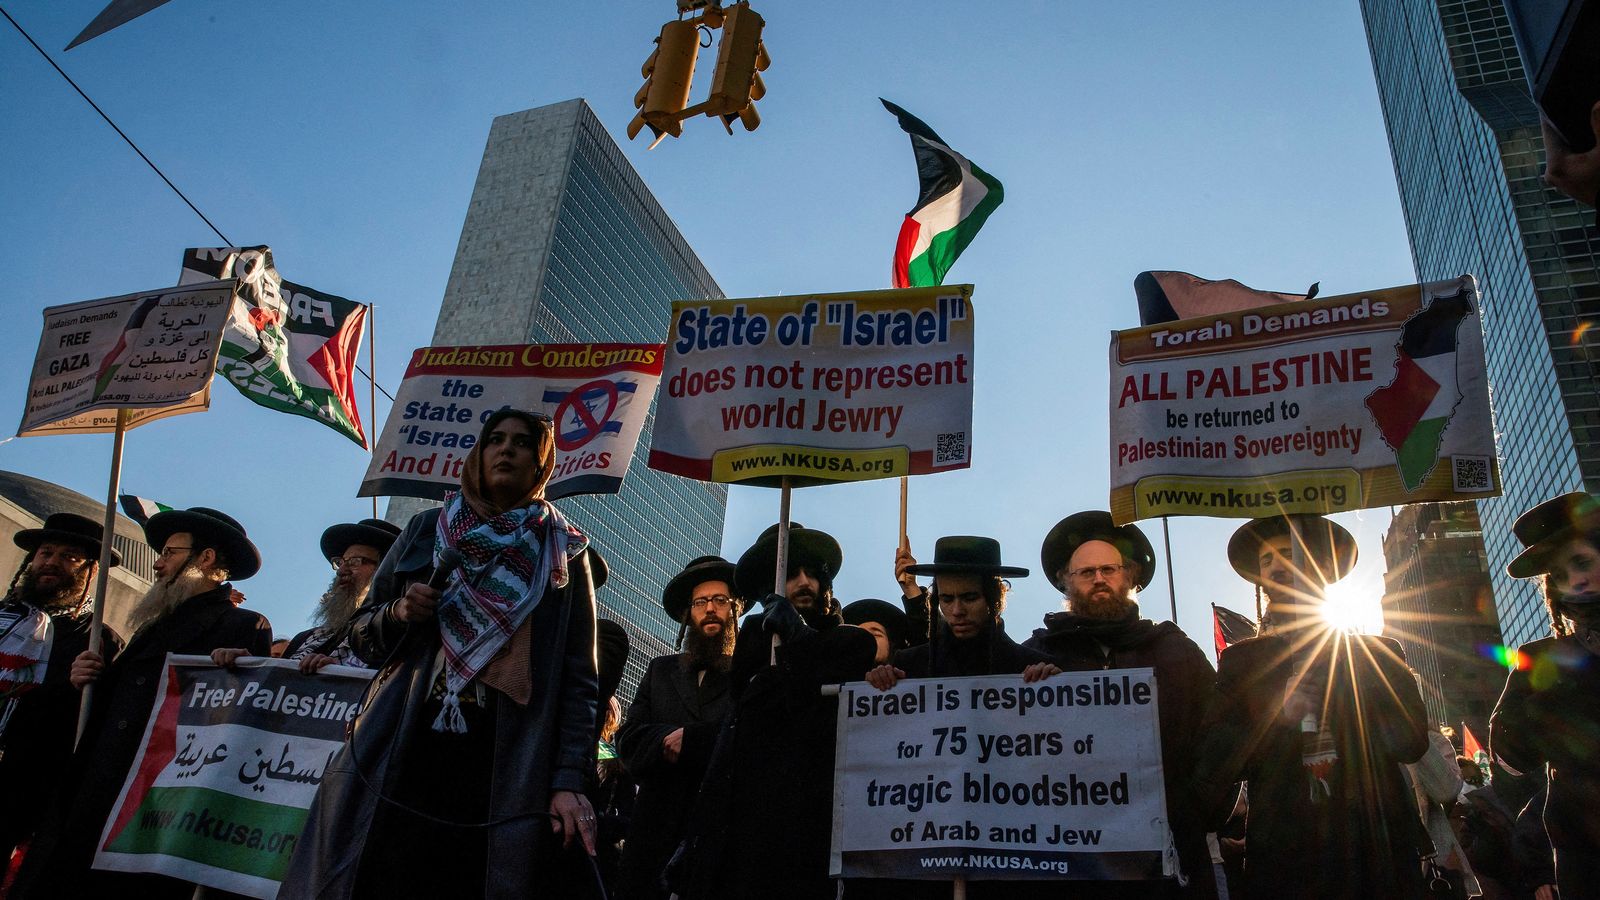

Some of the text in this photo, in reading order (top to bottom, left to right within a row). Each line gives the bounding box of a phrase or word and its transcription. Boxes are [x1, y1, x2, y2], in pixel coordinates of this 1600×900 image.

[80, 310, 118, 324] Demands
[158, 312, 206, 330] الحرية
[676, 297, 966, 354] State of "Israel"
[1150, 298, 1390, 348] Torah Demands
[59, 331, 91, 348] FREE
[159, 331, 184, 346] غزة
[49, 352, 90, 376] GAZA
[128, 348, 210, 368] كل فلسطين
[415, 344, 657, 368] Judaism Condemns
[45, 383, 60, 396] ALL
[441, 379, 484, 399] the
[668, 353, 968, 399] does not represent
[1118, 347, 1373, 409] ALL PALESTINE
[402, 401, 473, 424] State
[721, 397, 904, 438] world Jewry
[1165, 399, 1300, 429] be returned to
[1117, 423, 1363, 466] Palestinian Sovereignty
[380, 450, 612, 480] And it cities
[731, 452, 894, 474] www.NKUSA.org
[1146, 481, 1347, 509] www.nkusa.org
[187, 681, 363, 721] Free Palestine
[847, 676, 1151, 717] Israel is responsible
[897, 726, 1093, 764] for 75 years of
[174, 732, 335, 793] لسطين عربية
[867, 772, 1130, 813] tragic bloodshed
[889, 820, 1102, 845] of Arab and Jew
[920, 854, 1068, 874] www.NKUSA.org
